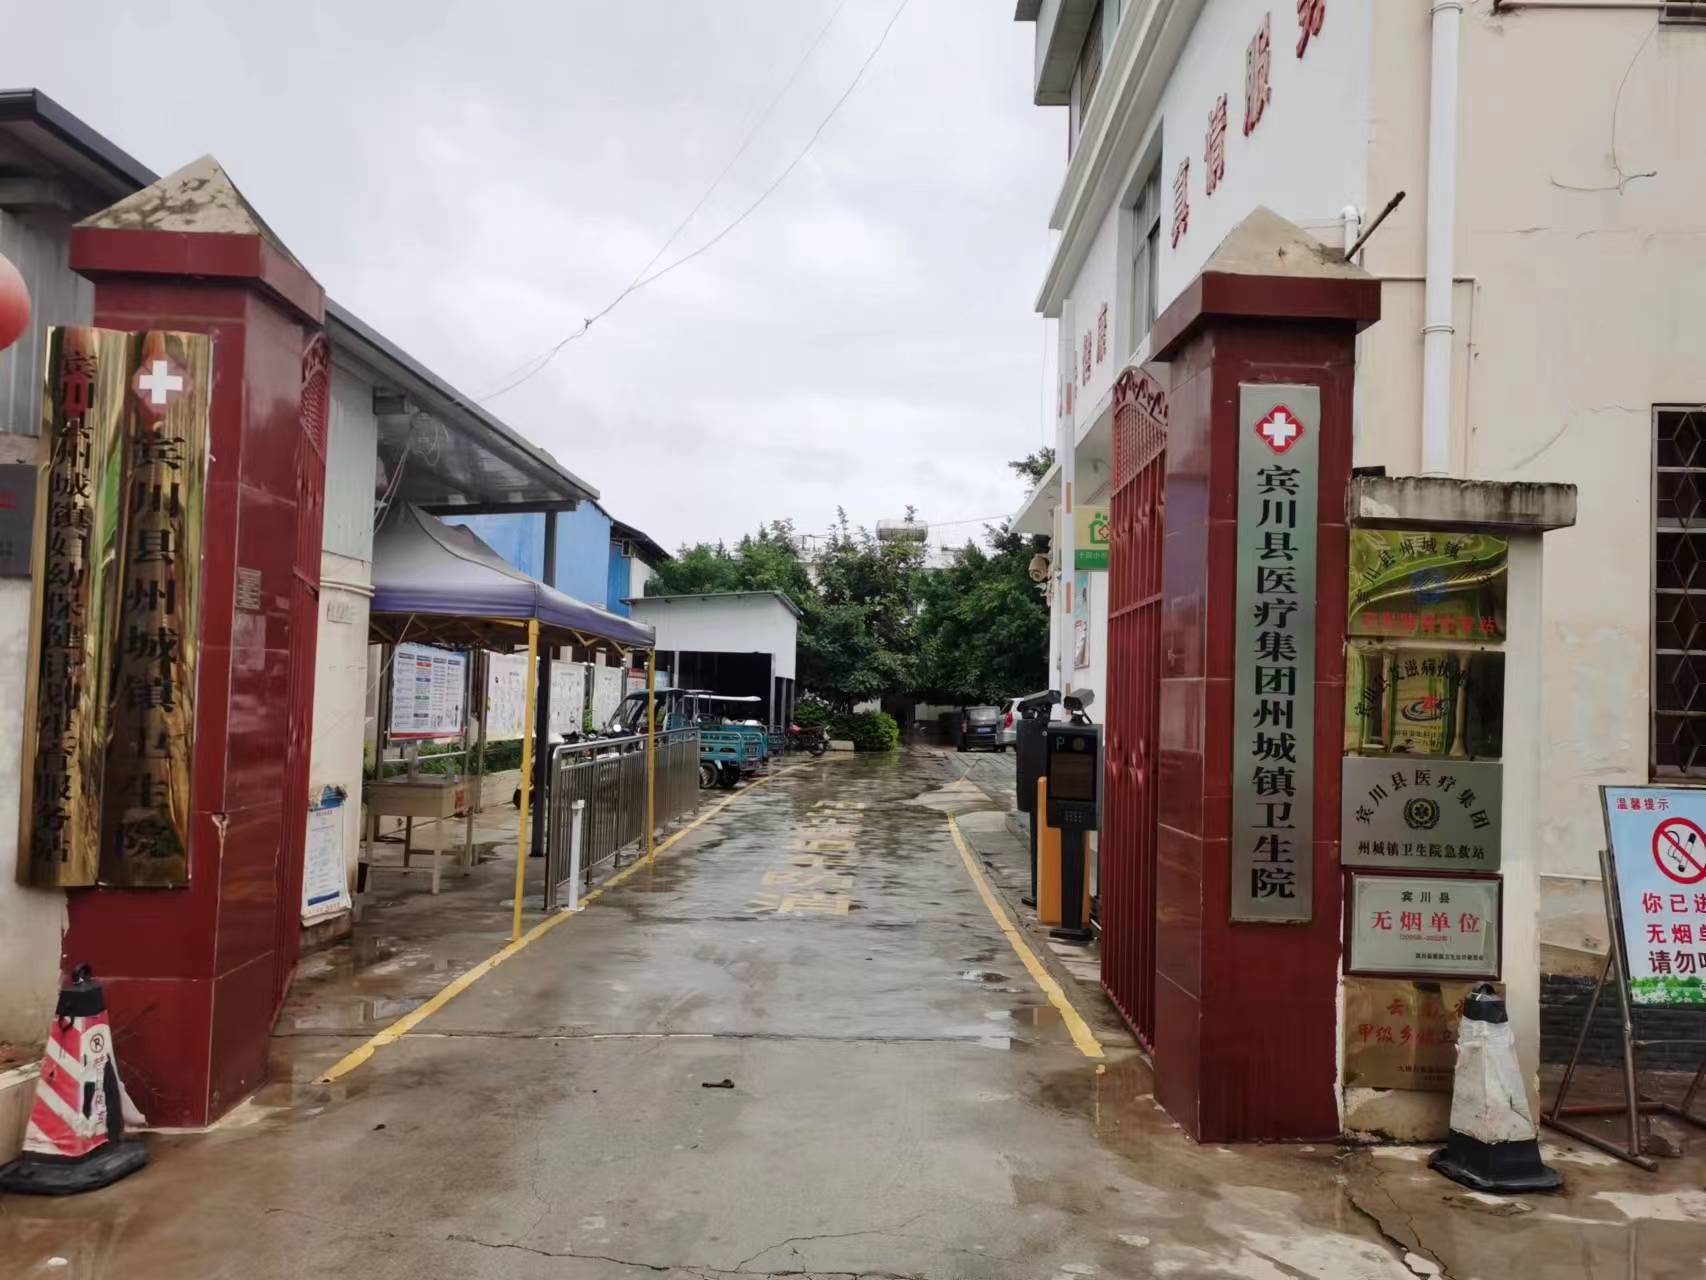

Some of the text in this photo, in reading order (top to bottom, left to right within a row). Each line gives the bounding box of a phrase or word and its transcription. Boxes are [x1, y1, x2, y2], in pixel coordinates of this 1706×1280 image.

[121, 435, 186, 857] 宾川县州城镇卫生院
[1251, 465, 1301, 898] 宾川县医疗集团州城镇卫生院
[1355, 769, 1491, 830] 宾川县医疗集团
[1616, 797, 1670, 811] 温馨提示
[1358, 840, 1485, 860] 州城镇卫生院急救站
[1401, 890, 1451, 904] 宾川县
[1371, 910, 1481, 933] 无烟单位
